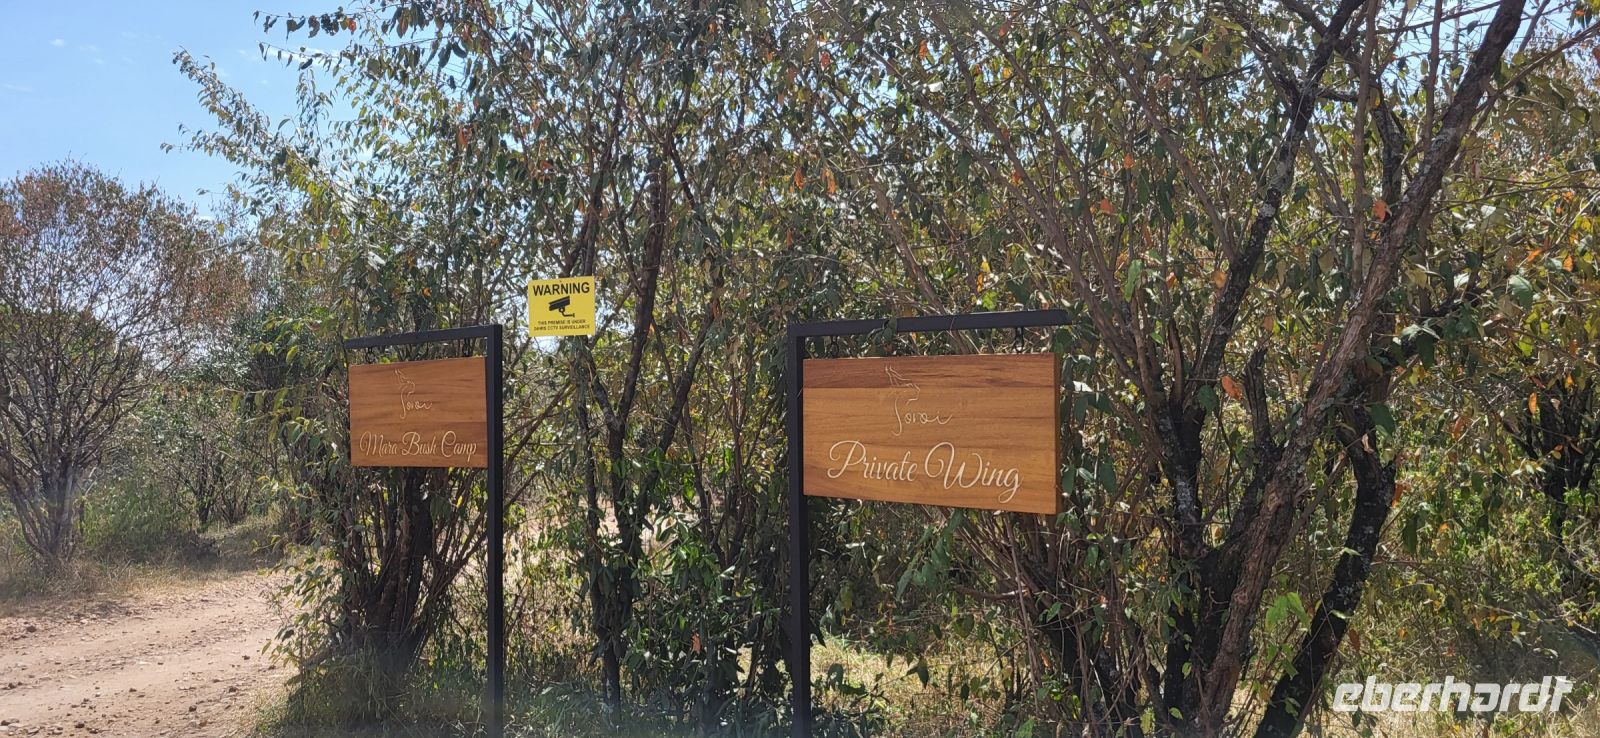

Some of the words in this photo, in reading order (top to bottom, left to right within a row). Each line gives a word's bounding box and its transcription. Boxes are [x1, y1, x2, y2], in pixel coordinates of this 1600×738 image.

[533, 282, 590, 296] WARNING
[360, 431, 398, 456] Mara
[401, 431, 436, 455] Bush
[441, 430, 477, 462] Camp
[827, 440, 918, 482] Private
[924, 441, 1022, 504] Wing
